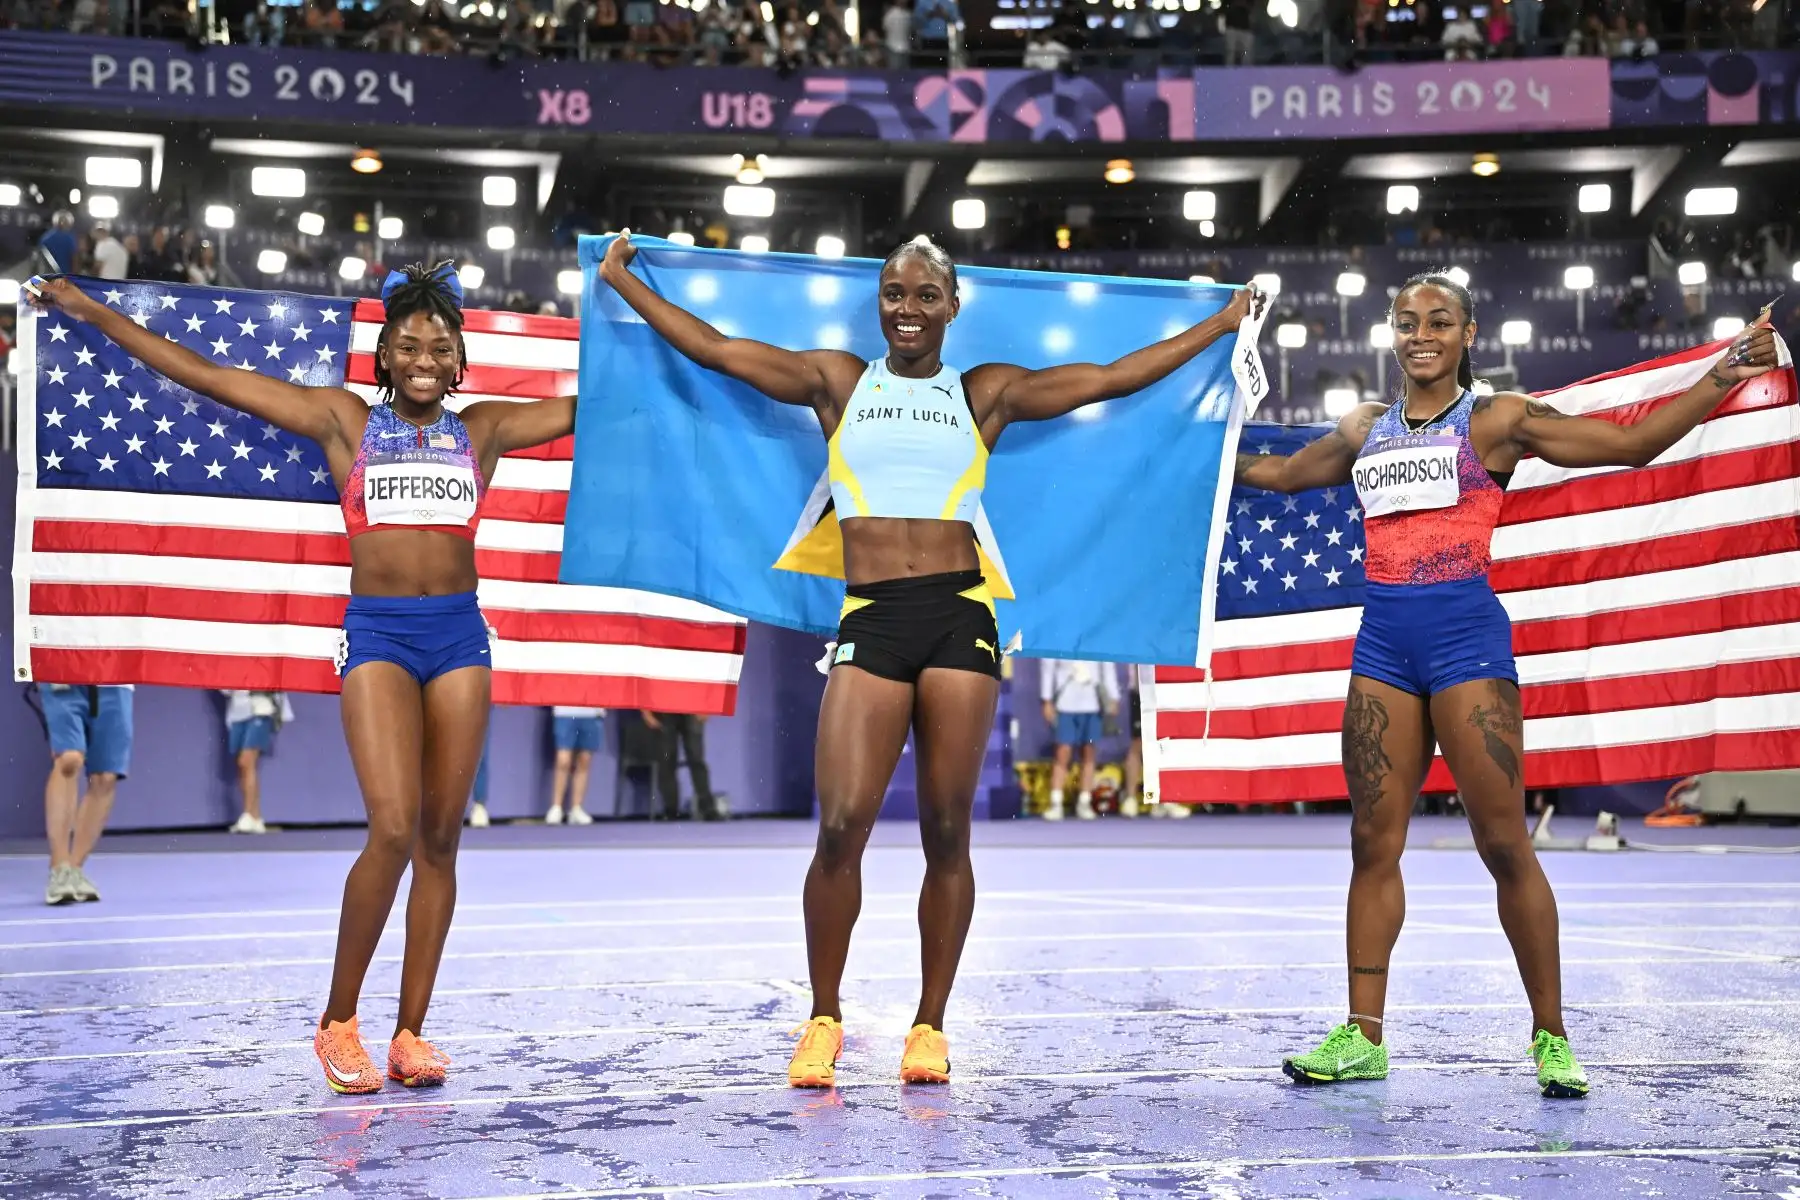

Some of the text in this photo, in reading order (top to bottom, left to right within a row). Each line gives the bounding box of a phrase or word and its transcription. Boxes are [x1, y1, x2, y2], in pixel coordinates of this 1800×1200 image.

[91, 54, 414, 106] PARIS 2024
[1250, 76, 1550, 119] PARIS 2024
[537, 89, 592, 124] X8
[702, 92, 774, 128] U18
[857, 408, 959, 428] SAINT LUCIA
[425, 453, 448, 461] 2024
[1379, 439, 1402, 450] PARIS
[368, 476, 474, 502] JEFFERSON
[1355, 457, 1454, 494] RICHARDSON
